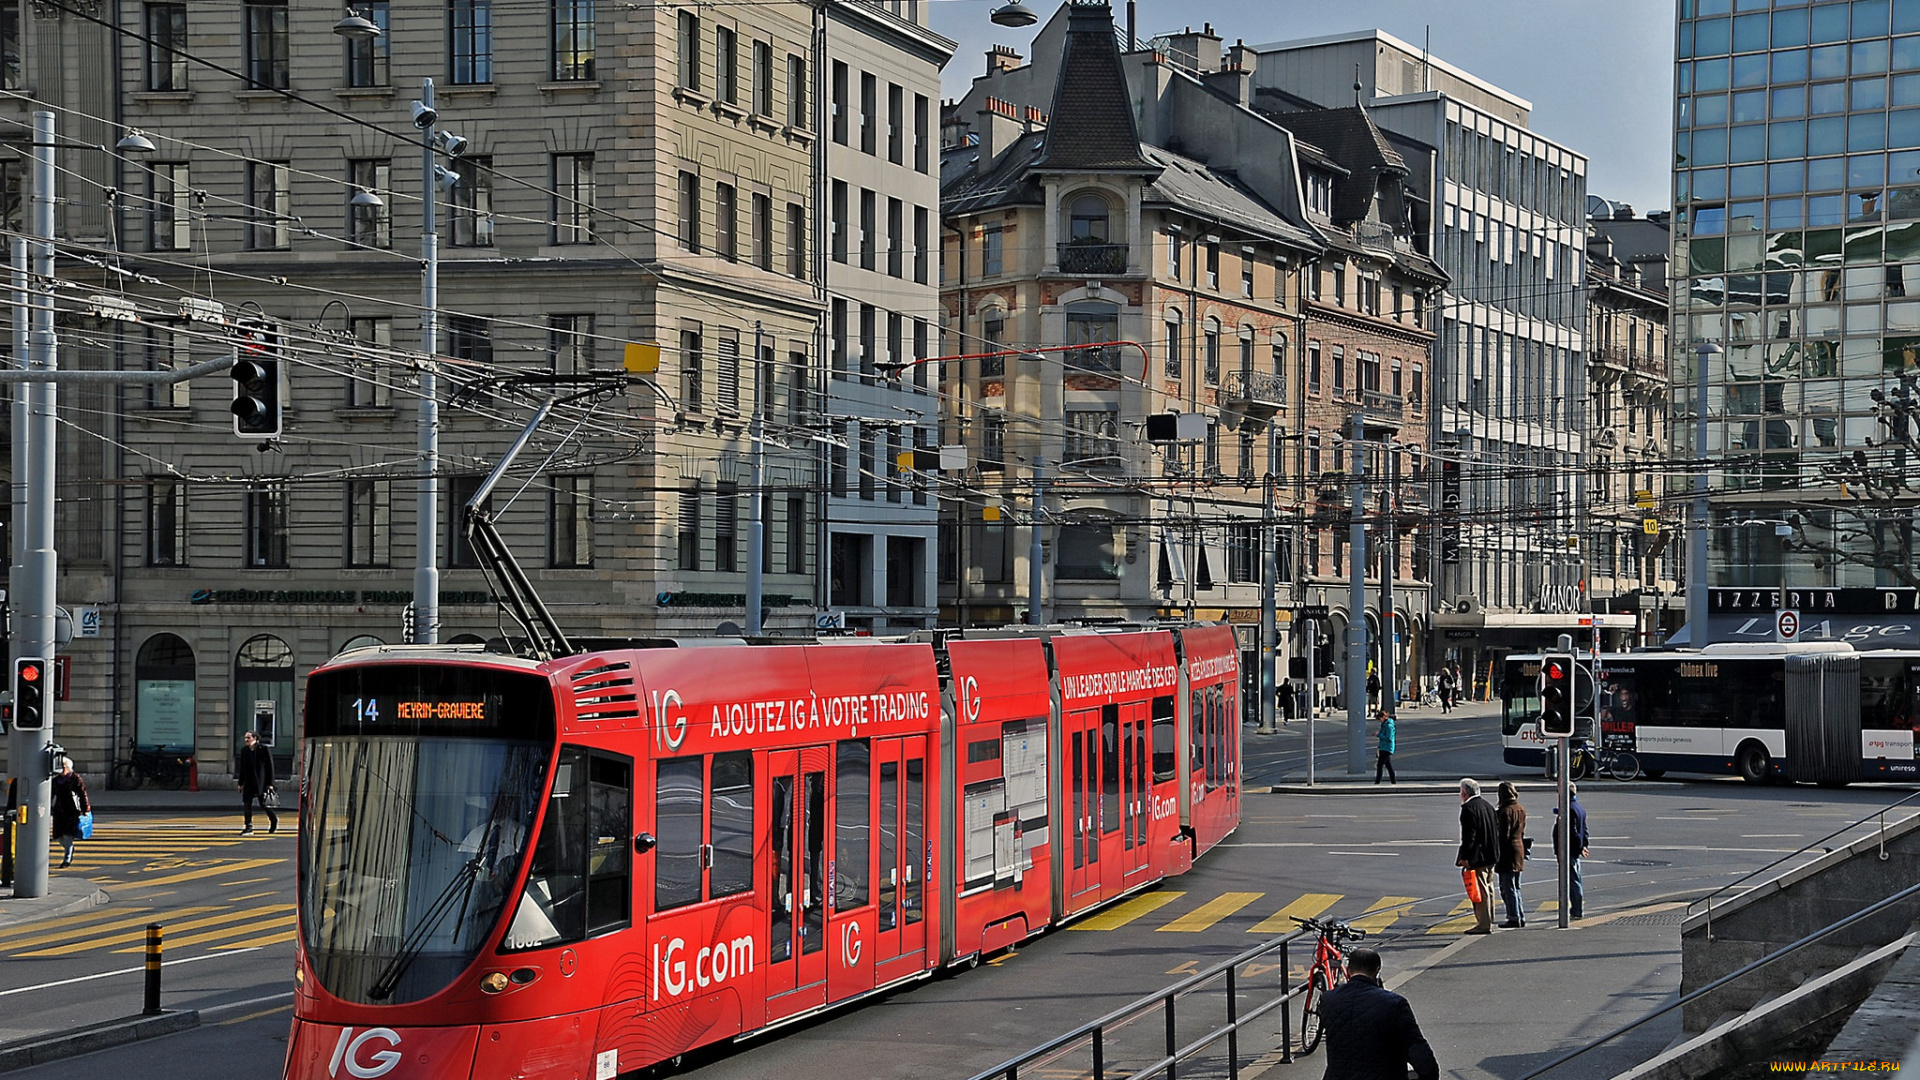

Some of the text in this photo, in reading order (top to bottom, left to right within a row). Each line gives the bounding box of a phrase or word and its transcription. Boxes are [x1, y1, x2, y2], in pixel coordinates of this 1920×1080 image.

[1646, 522, 1656, 531] 10
[215, 588, 271, 603] CRÉDIT
[274, 590, 356, 603] AGRICOLE
[1539, 584, 1581, 612] MANOR
[1718, 592, 1834, 607] IZZERIA
[1063, 662, 1177, 699] UN LEADER SUR LE MARCHÉ DES CFD
[1705, 662, 1718, 677] live
[352, 698, 485, 722] 14 MEYRIN-GRAVIERE
[960, 675, 980, 723] IG
[652, 688, 686, 752] IG
[710, 689, 929, 737] AJOUTEZ IG À VOTRE TRADING
[1601, 721, 1634, 733] MILLER
[1152, 795, 1176, 821] IG.com
[509, 931, 542, 949] 1802
[841, 920, 862, 969] IG
[653, 934, 754, 1001] IG.com
[328, 1027, 402, 1079] IG
